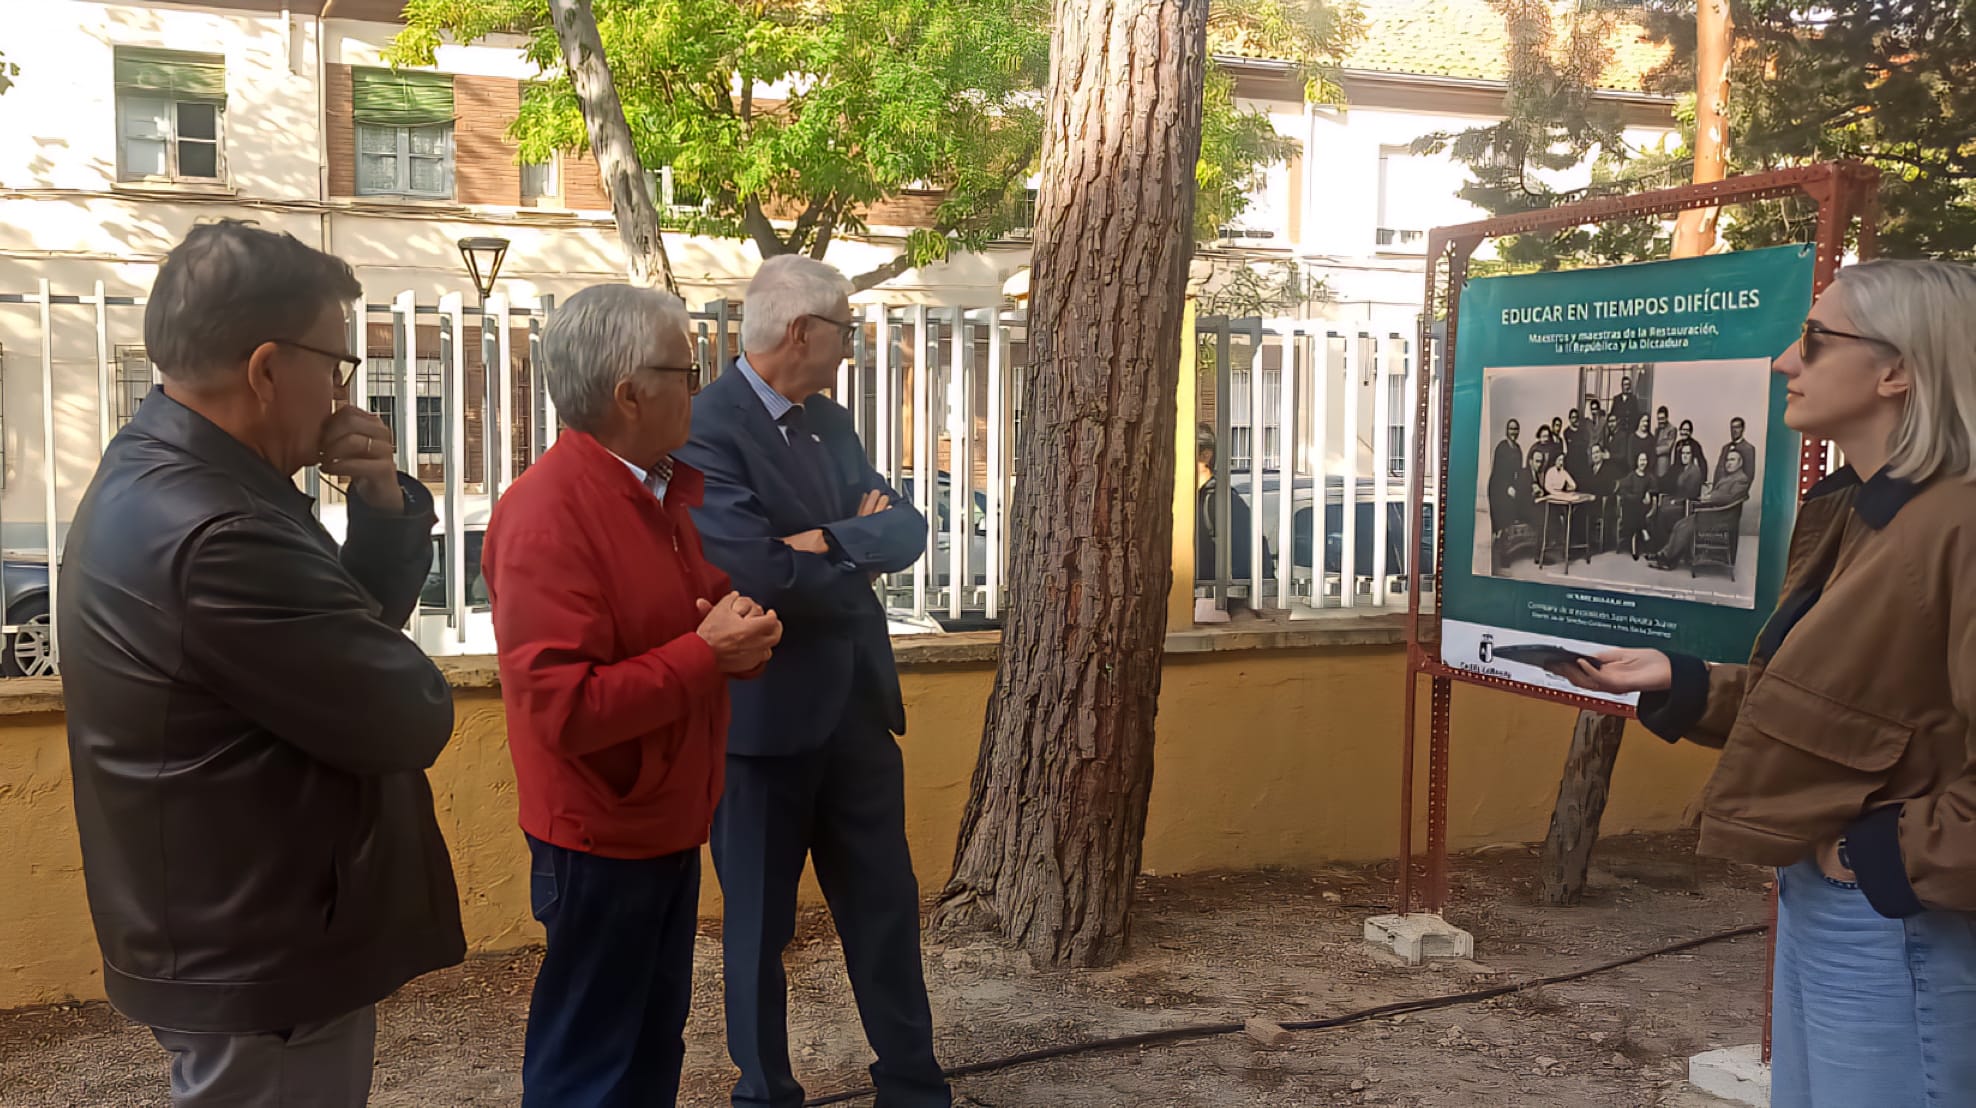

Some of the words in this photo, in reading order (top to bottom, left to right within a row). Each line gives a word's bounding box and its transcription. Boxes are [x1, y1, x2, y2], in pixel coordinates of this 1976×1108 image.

[1501, 305, 1563, 325] EDUCAR
[1567, 303, 1588, 321] EN
[1593, 297, 1669, 319] TIEMPOS
[1674, 288, 1760, 312] DIFÍCILES
[1529, 332, 1569, 343] Maestros
[1578, 330, 1621, 341] maestras
[1623, 328, 1635, 339] de
[1638, 327, 1647, 338] la
[1649, 323, 1719, 337] Restauración,
[1555, 340, 1563, 352] la
[1573, 339, 1618, 353] República
[1620, 341, 1627, 353] y
[1628, 339, 1637, 350] la
[1640, 336, 1688, 349] Dictadura
